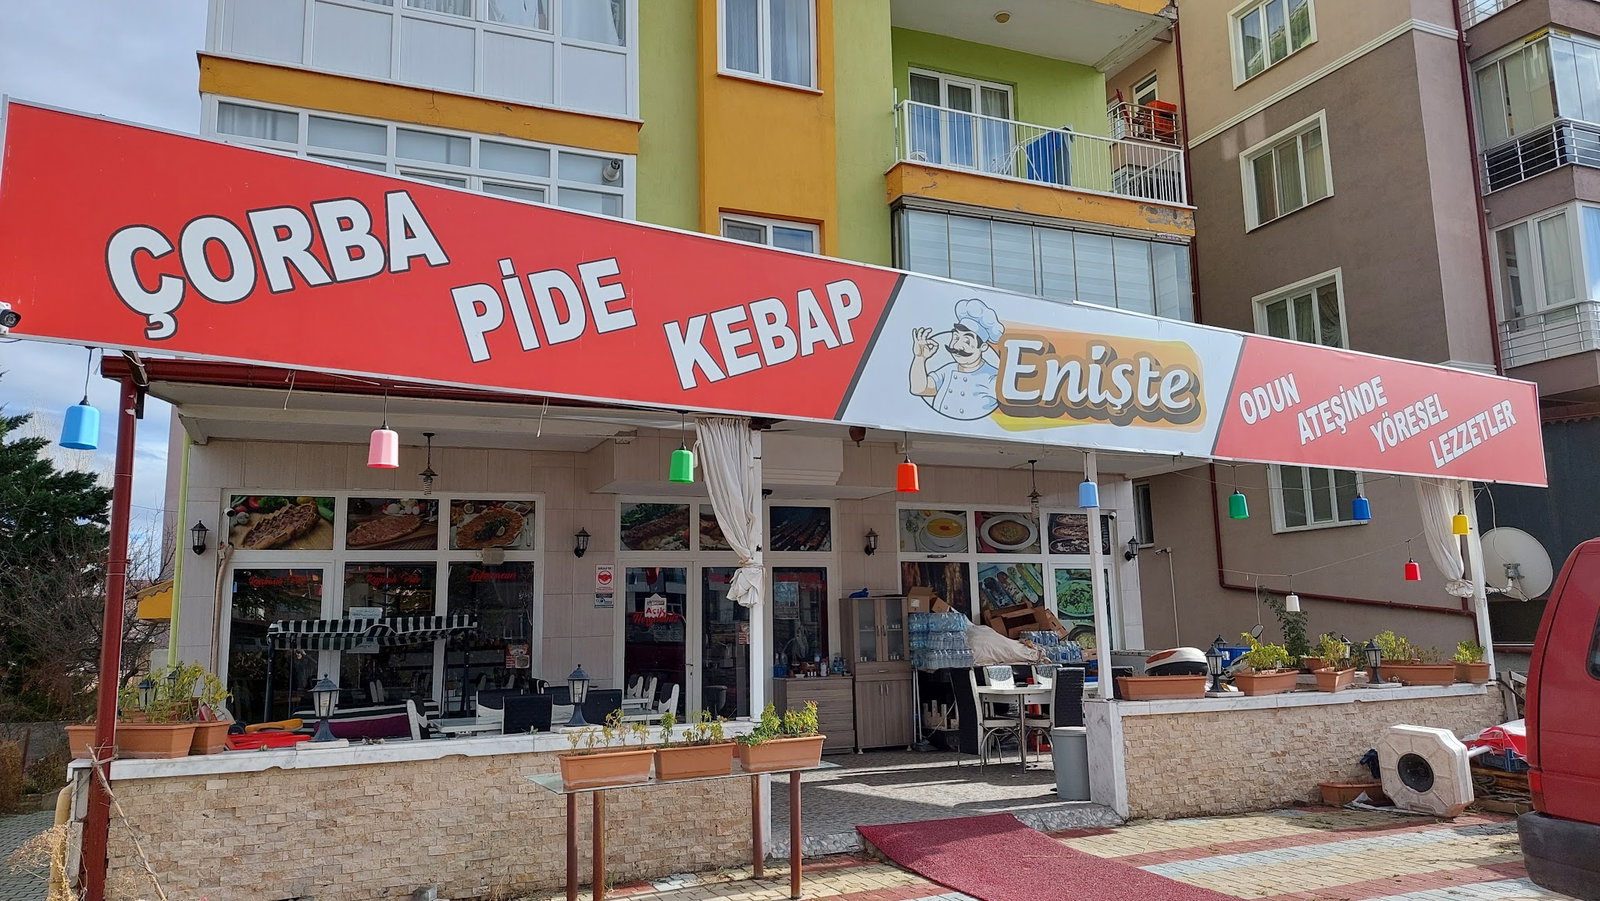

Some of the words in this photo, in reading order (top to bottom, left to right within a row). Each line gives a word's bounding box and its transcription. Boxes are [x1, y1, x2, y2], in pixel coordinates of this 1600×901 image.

[105, 190, 451, 340] ÇORBA
[450, 257, 637, 364] PİDE
[663, 278, 863, 391] KEBAP
[1000, 338, 1193, 413] Enişte
[1238, 372, 1301, 426] ODUN
[1296, 375, 1389, 446] ATEŞİNDE
[1369, 392, 1449, 453] YÖRESEL
[1428, 399, 1517, 470] LEZZETLER
